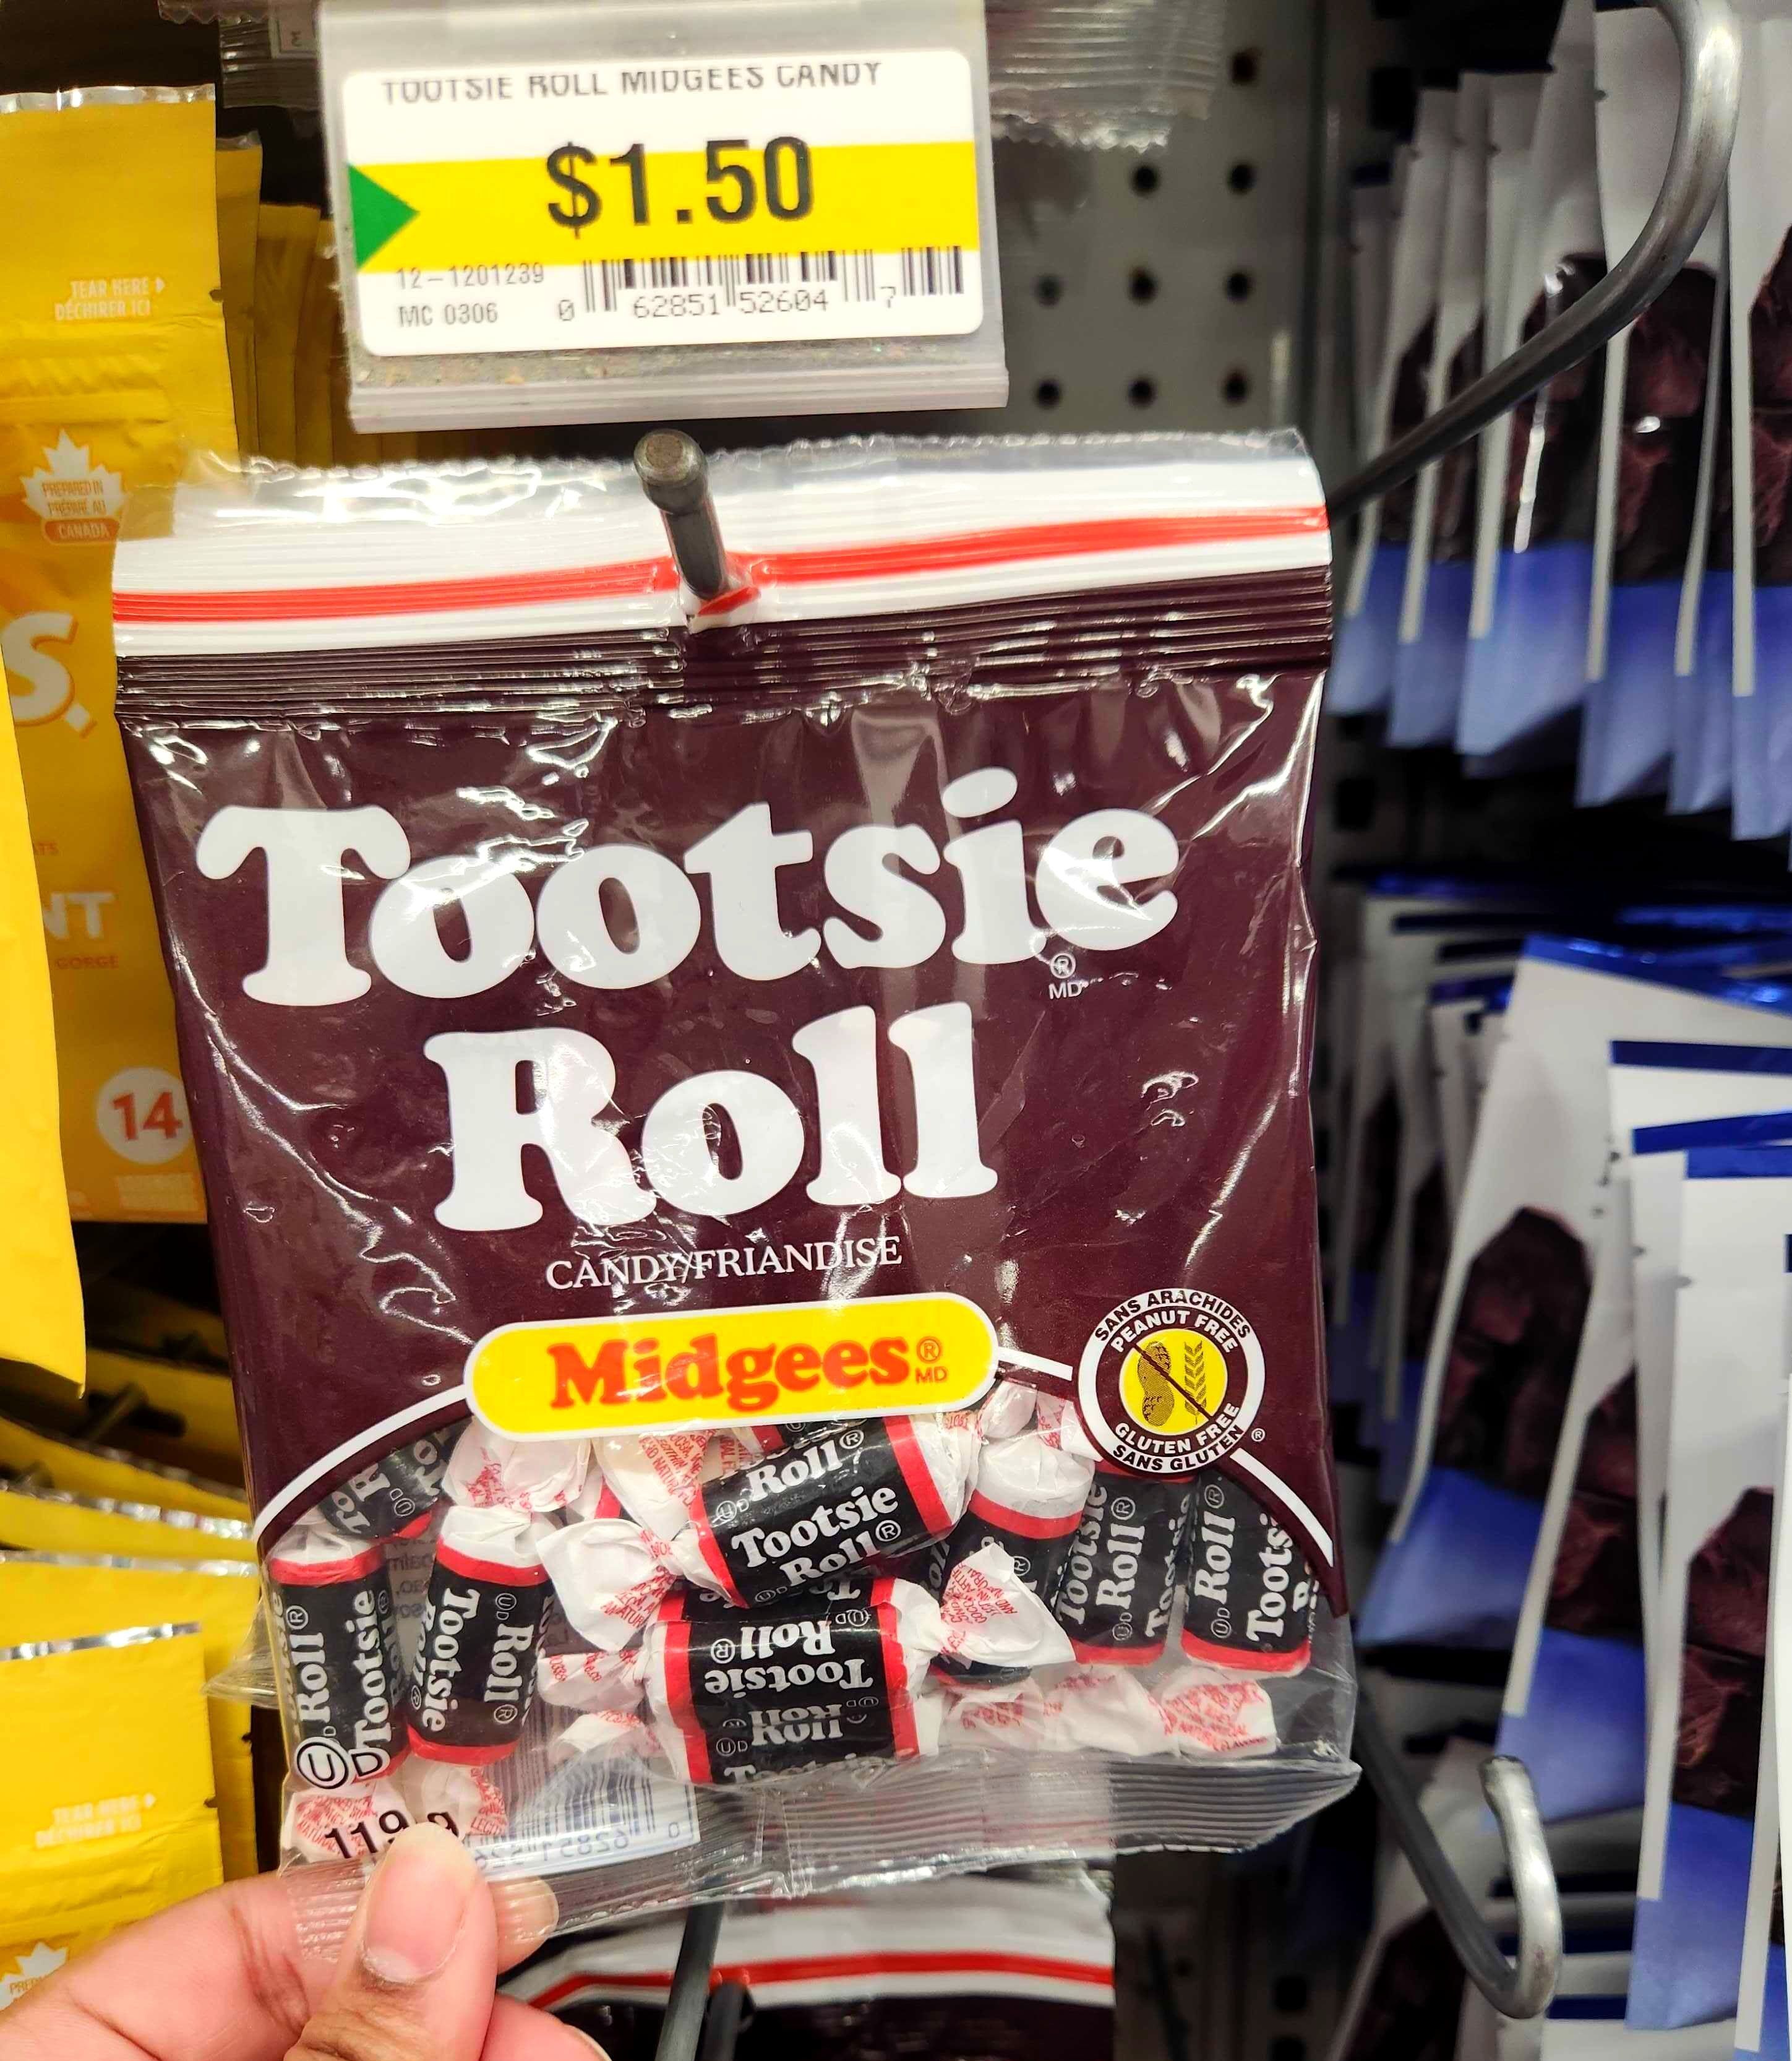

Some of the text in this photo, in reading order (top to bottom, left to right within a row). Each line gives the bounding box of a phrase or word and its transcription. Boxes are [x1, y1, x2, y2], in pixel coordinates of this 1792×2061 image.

[382, 61, 883, 105] TOOTSIE ROLL MIDGEES CANDY
[545, 135, 815, 239] $1.50
[70, 277, 150, 299] TEAR HERE
[395, 262, 545, 290] 12-1201239
[398, 301, 499, 328] MC 0306
[557, 299, 575, 322] 0
[633, 291, 721, 320] 62851
[739, 289, 830, 316] 52604
[58, 522, 110, 540] CANADA
[195, 766, 1179, 1007] Tootsie
[1048, 981, 1081, 1000] MD
[111, 1091, 184, 1142] 14
[424, 1002, 998, 1233] Roll
[1094, 1289, 1251, 1341] SANS ARACHIDES
[1110, 1310, 1238, 1353] PEANUT FREE
[546, 1333, 911, 1414] Midgees
[915, 1366, 948, 1385] MD
[1112, 1424, 1245, 1471] SANS GLUTEN
[1115, 1403, 1240, 1455] GLUTEN FREE
[745, 1440, 843, 1503] Roll
[731, 1485, 899, 1570] Tootsie
[780, 1530, 881, 1588] Roll
[1095, 1523, 1146, 1610] Roll
[1193, 1512, 1236, 1609] Roll
[1245, 1512, 1295, 1642] Toots
[421, 1588, 482, 1732] Tootsie
[486, 1623, 535, 1703] Roll
[740, 1619, 836, 1656] Roll
[291, 1631, 332, 1724] Roll
[344, 1589, 393, 1750] Tootsie
[704, 1658, 874, 1699] Tootsie
